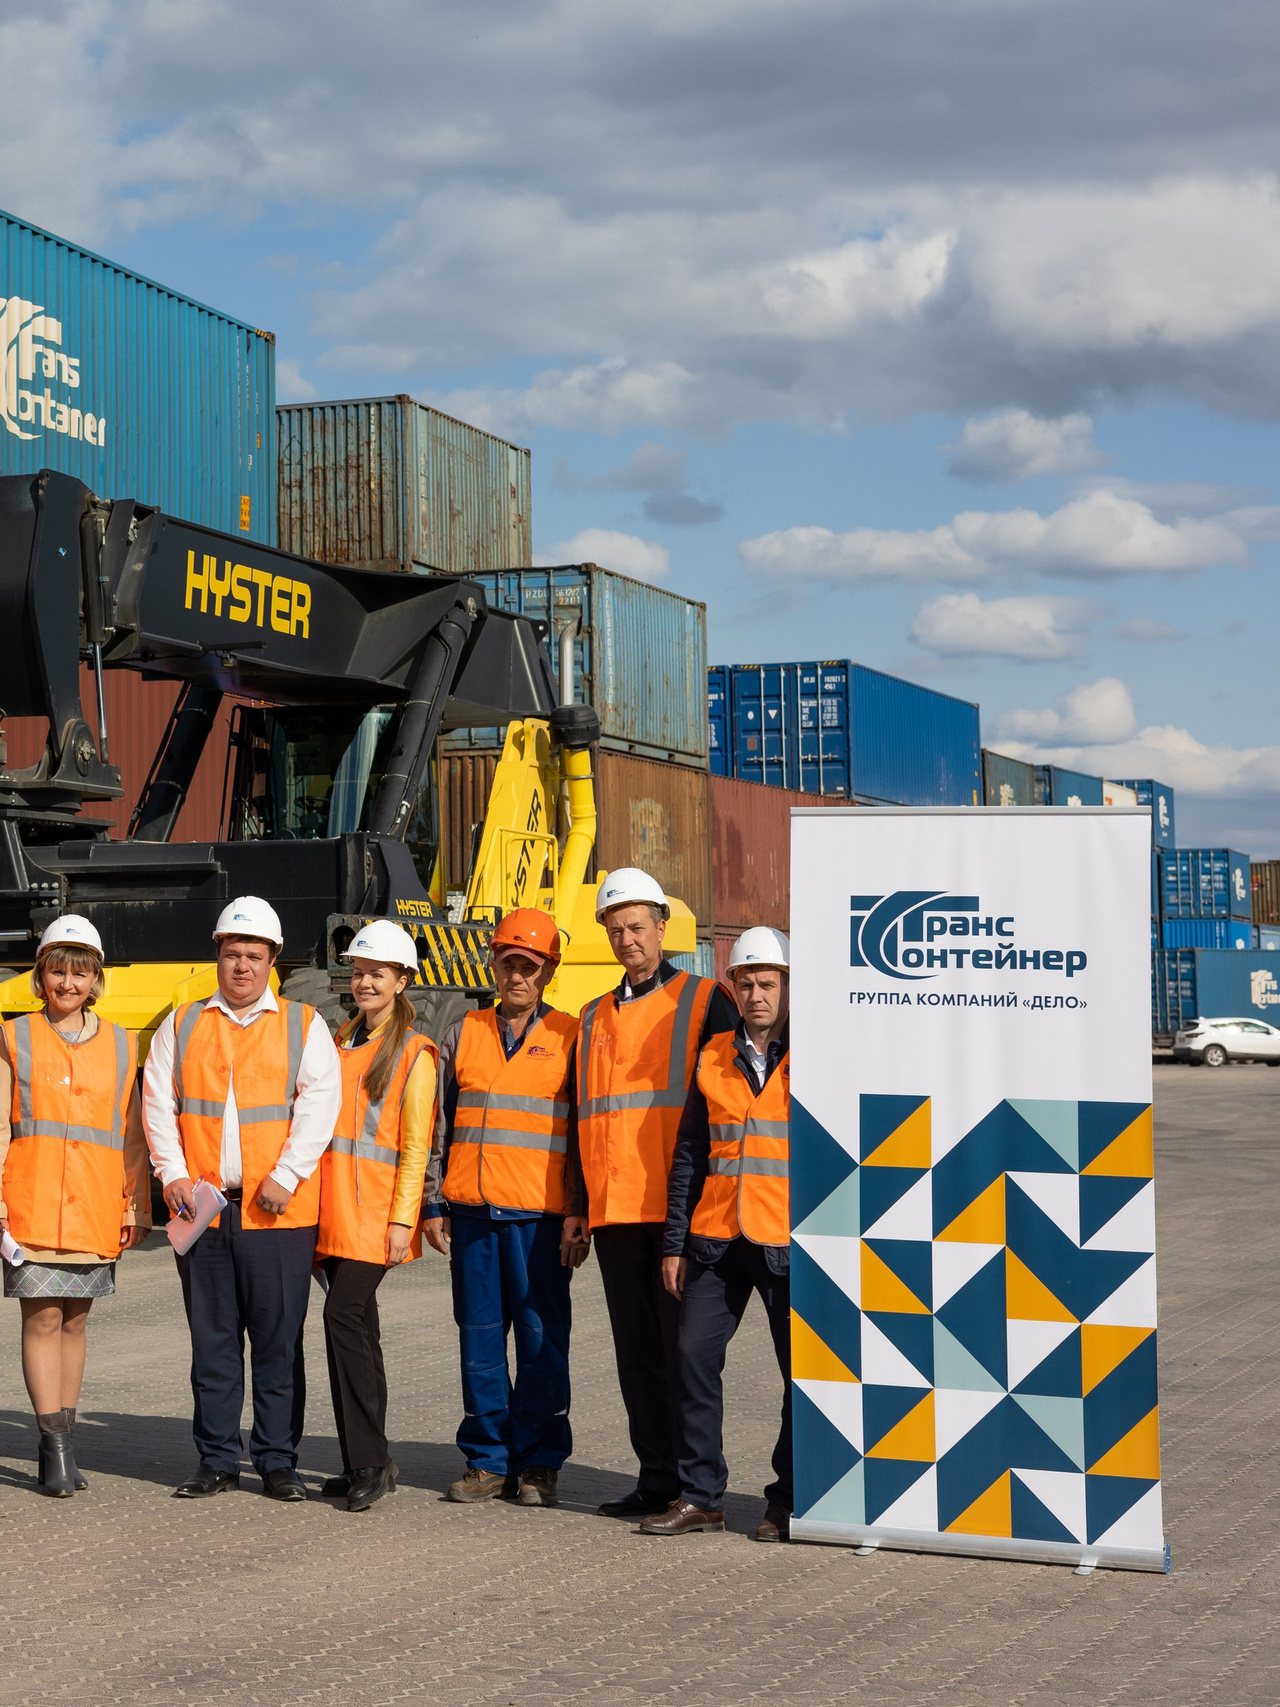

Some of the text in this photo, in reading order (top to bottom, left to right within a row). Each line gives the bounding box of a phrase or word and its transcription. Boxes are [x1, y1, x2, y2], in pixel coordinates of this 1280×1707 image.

[185, 549, 312, 639] HYSTER
[395, 898, 433, 918] HYSTER
[849, 991, 1088, 1011] ГРУППА КОМПАНИЙ «ДЕЛО»
